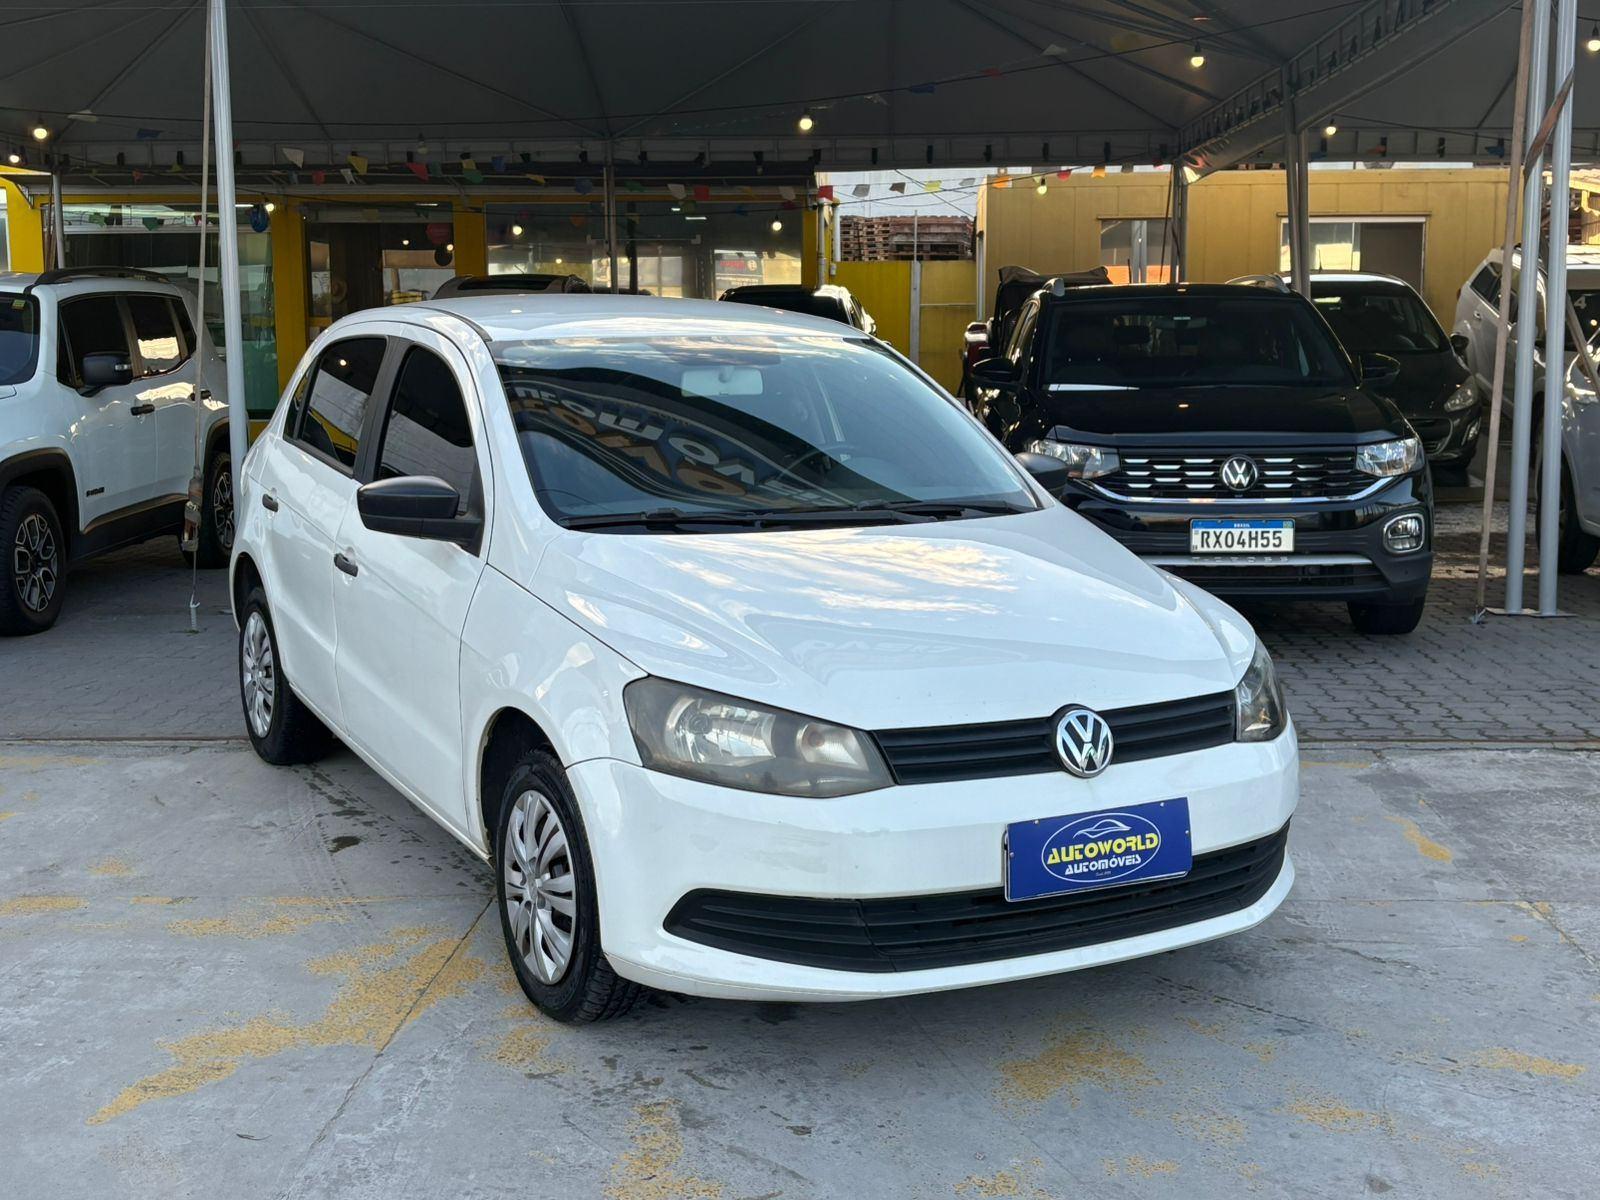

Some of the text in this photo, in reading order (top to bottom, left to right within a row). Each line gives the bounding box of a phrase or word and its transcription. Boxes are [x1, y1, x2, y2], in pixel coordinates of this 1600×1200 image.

[1057, 709, 1113, 776] VW
[1046, 832, 1159, 865] AUTOWORLD
[1064, 853, 1142, 876] AUTOMÓVEIS
